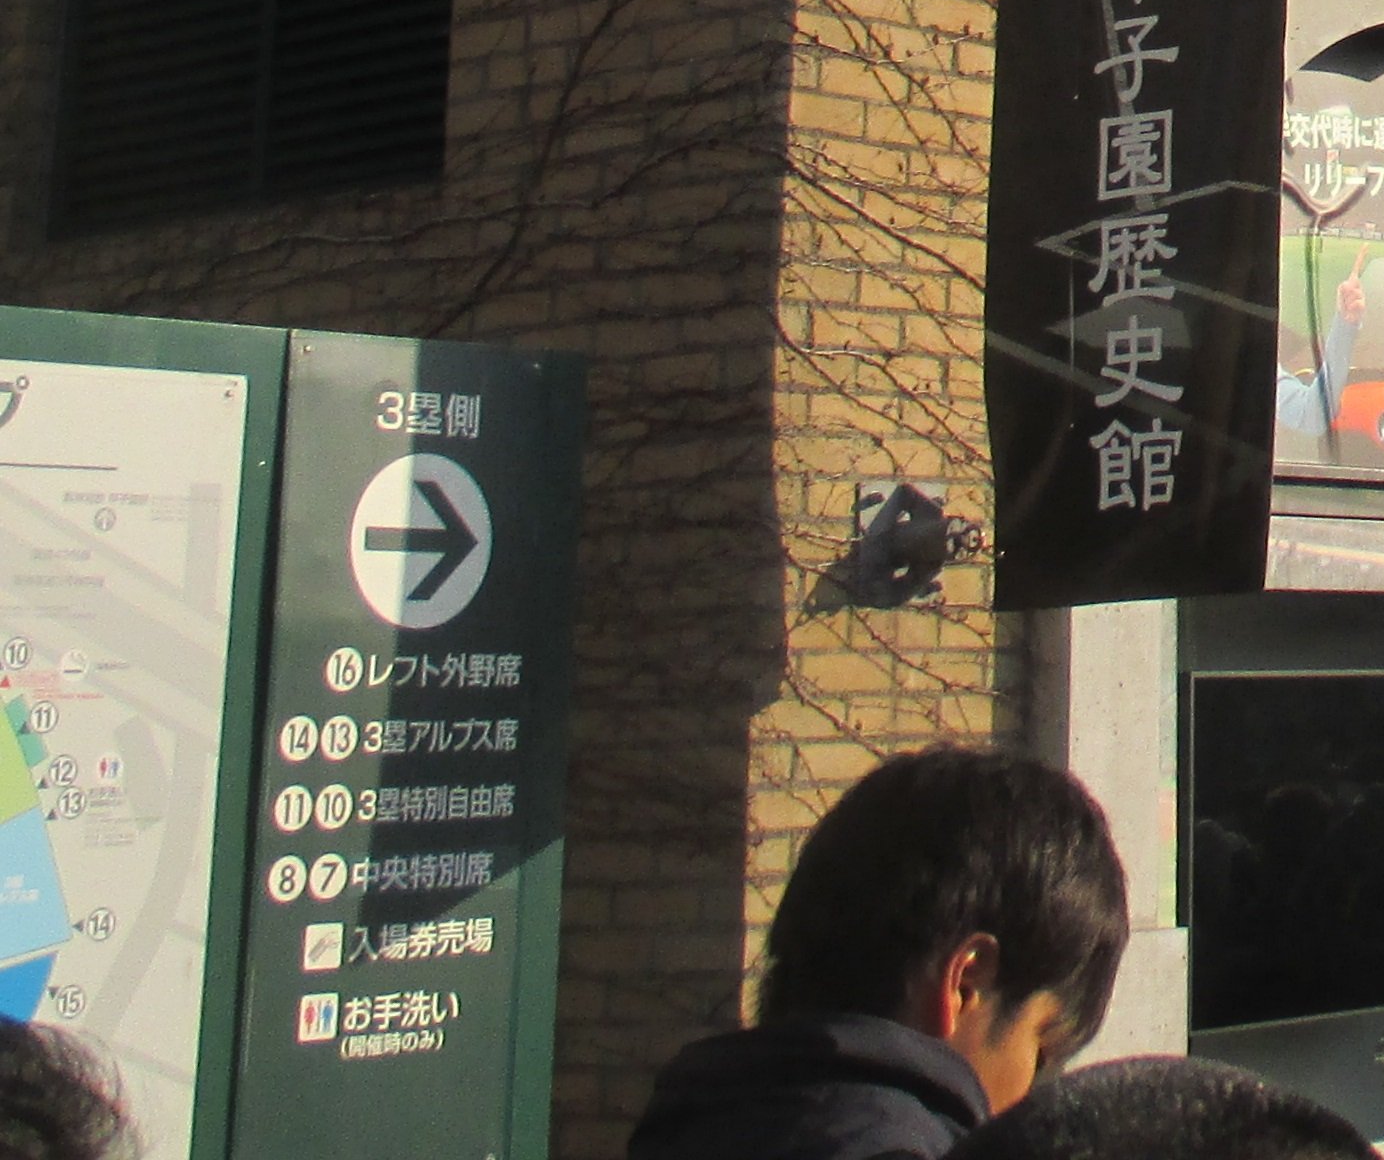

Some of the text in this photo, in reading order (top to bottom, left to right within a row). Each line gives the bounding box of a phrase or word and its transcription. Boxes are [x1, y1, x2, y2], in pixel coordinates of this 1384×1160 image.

[377, 391, 481, 439] 3塁側
[330, 649, 522, 689] 16 レフト外野席
[284, 718, 518, 757] 14 13 3塁アルプス席
[280, 783, 516, 828] 11 10 3塁特別自由席
[352, 851, 494, 892] 中央特別席
[348, 917, 493, 963] 入場券売場
[343, 990, 461, 1031] お手洗い
[340, 1029, 445, 1060] (開催時のみ)
